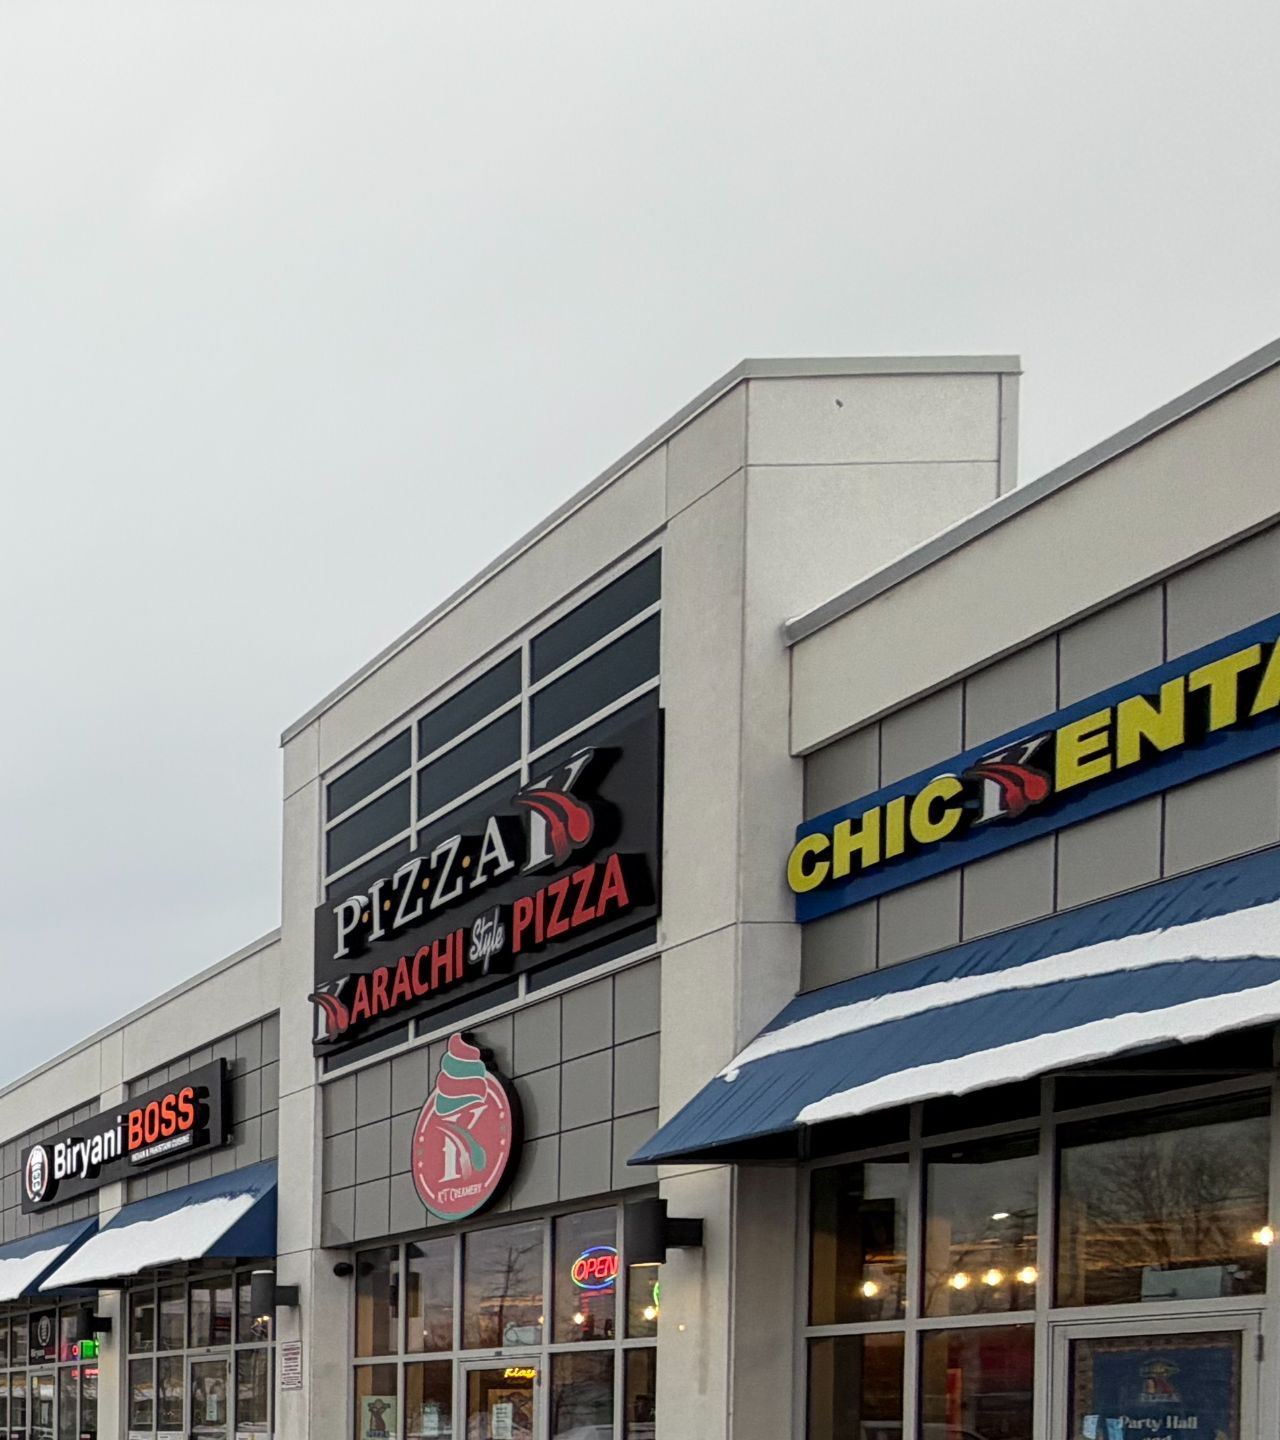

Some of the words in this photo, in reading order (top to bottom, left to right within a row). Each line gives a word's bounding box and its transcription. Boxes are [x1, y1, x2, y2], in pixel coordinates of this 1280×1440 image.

[469, 906, 506, 975] Style
[512, 853, 630, 953] PIZZA
[54, 1114, 122, 1179] Biryani
[128, 1087, 195, 1150] BOSS
[574, 1256, 618, 1281] OPEN
[1120, 1415, 1161, 1432] Party
[1166, 1415, 1198, 1429] Hall
